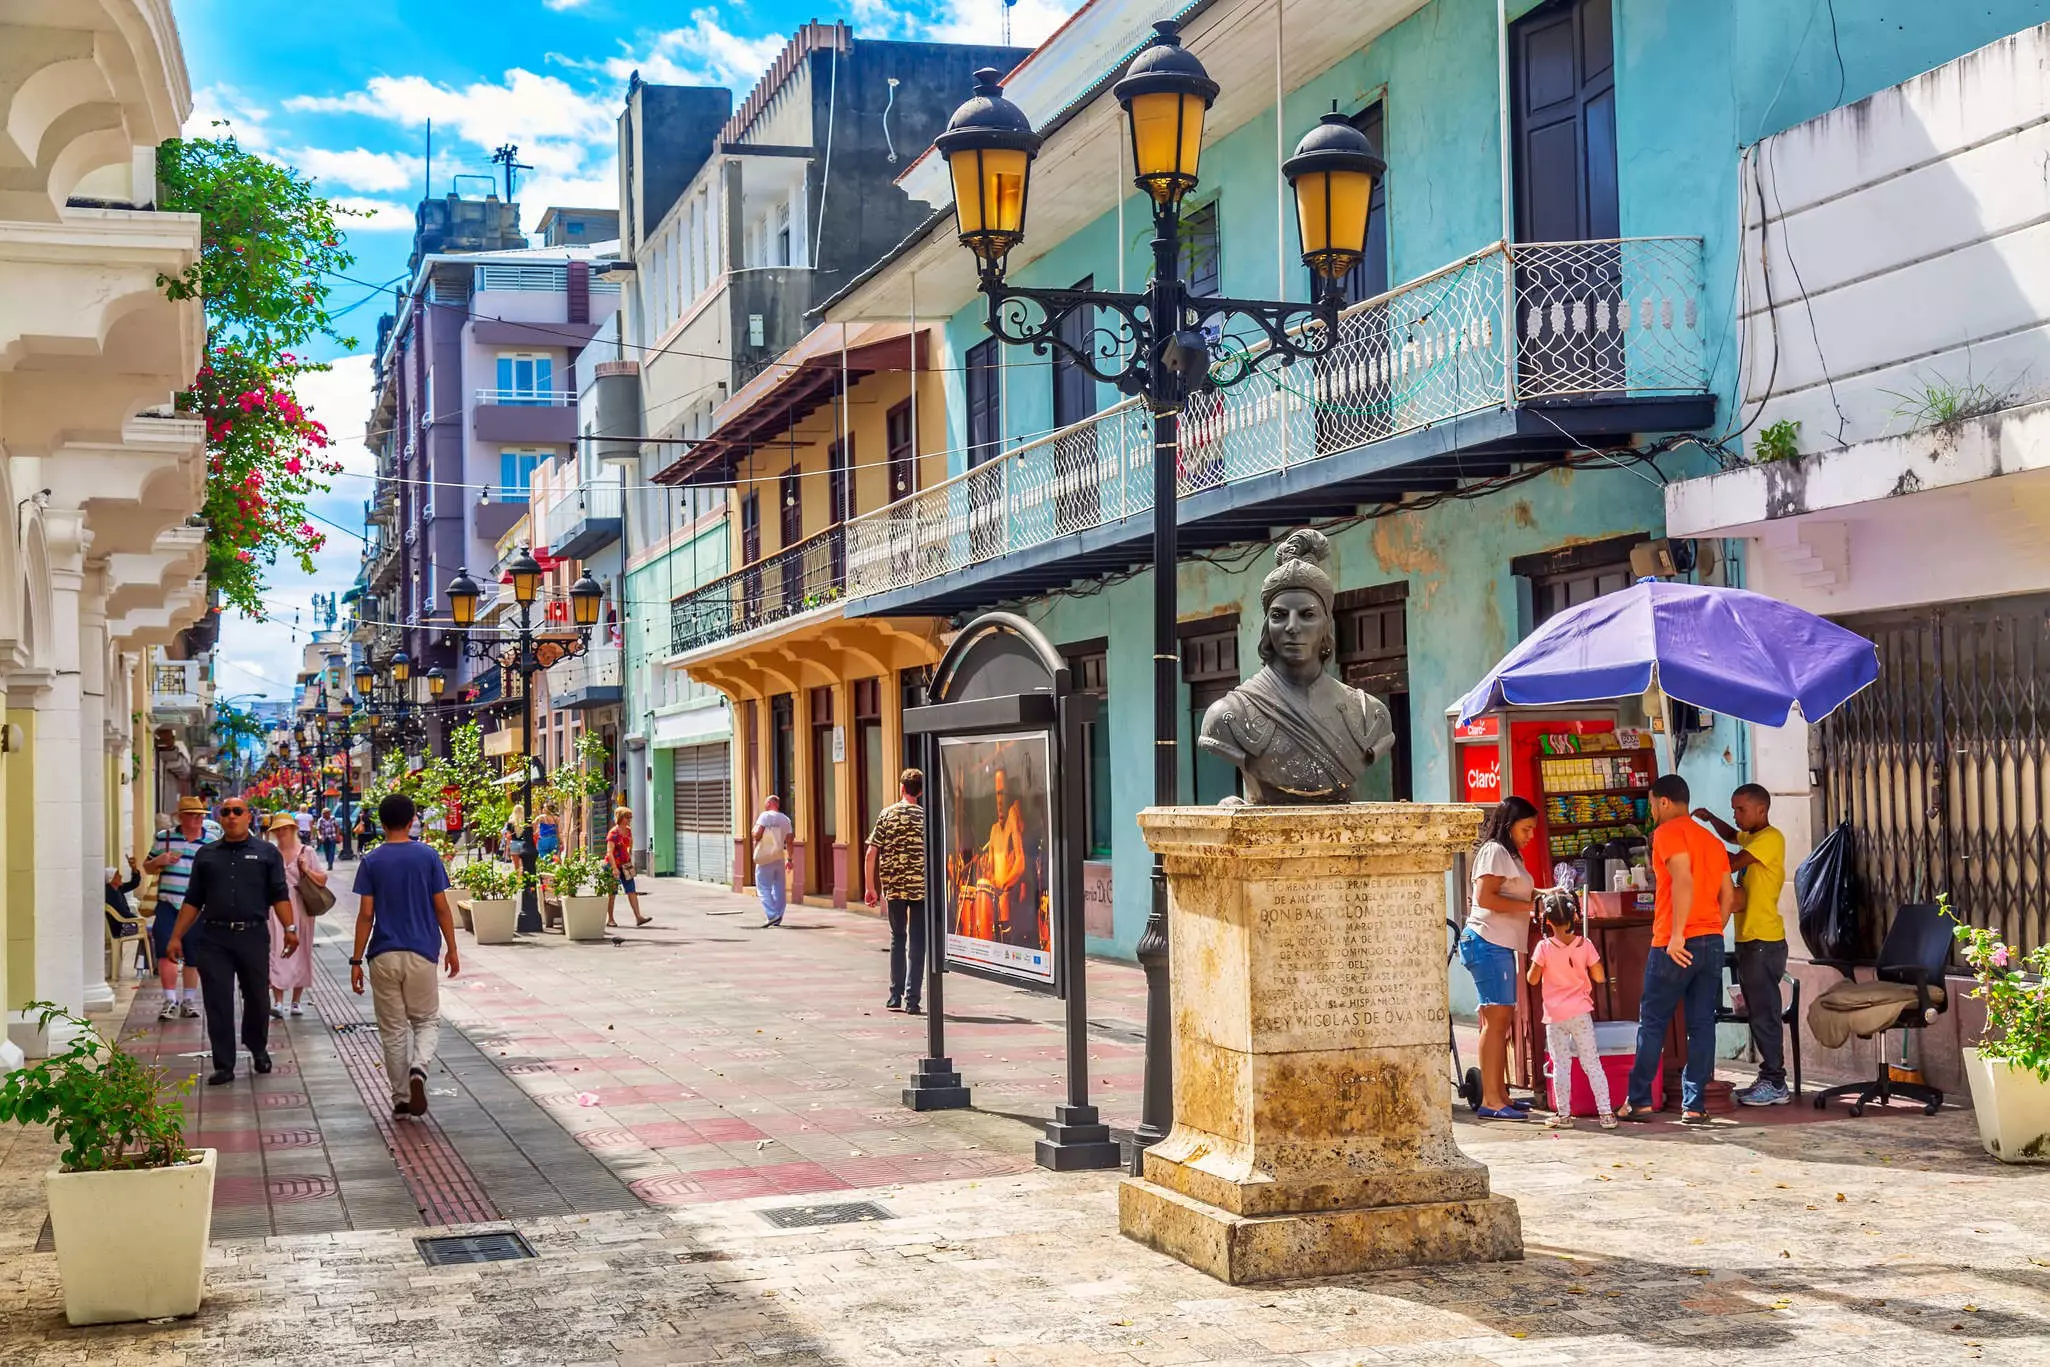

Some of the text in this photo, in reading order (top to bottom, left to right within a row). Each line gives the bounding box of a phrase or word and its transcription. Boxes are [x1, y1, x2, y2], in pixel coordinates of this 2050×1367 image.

[1467, 725, 1483, 735] Claro
[1467, 769, 1497, 788] Claro
[1274, 896, 1287, 905] DE
[1260, 908, 1291, 922] DON
[1361, 935, 1372, 944] DE
[1279, 950, 1291, 960] DE
[1294, 949, 1329, 960] SANTO
[1348, 960, 1365, 969] DEL
[1296, 1012, 1359, 1028] NICOLAS
[1364, 1011, 1380, 1025] DE
[1384, 1007, 1446, 1024] OVANDO
